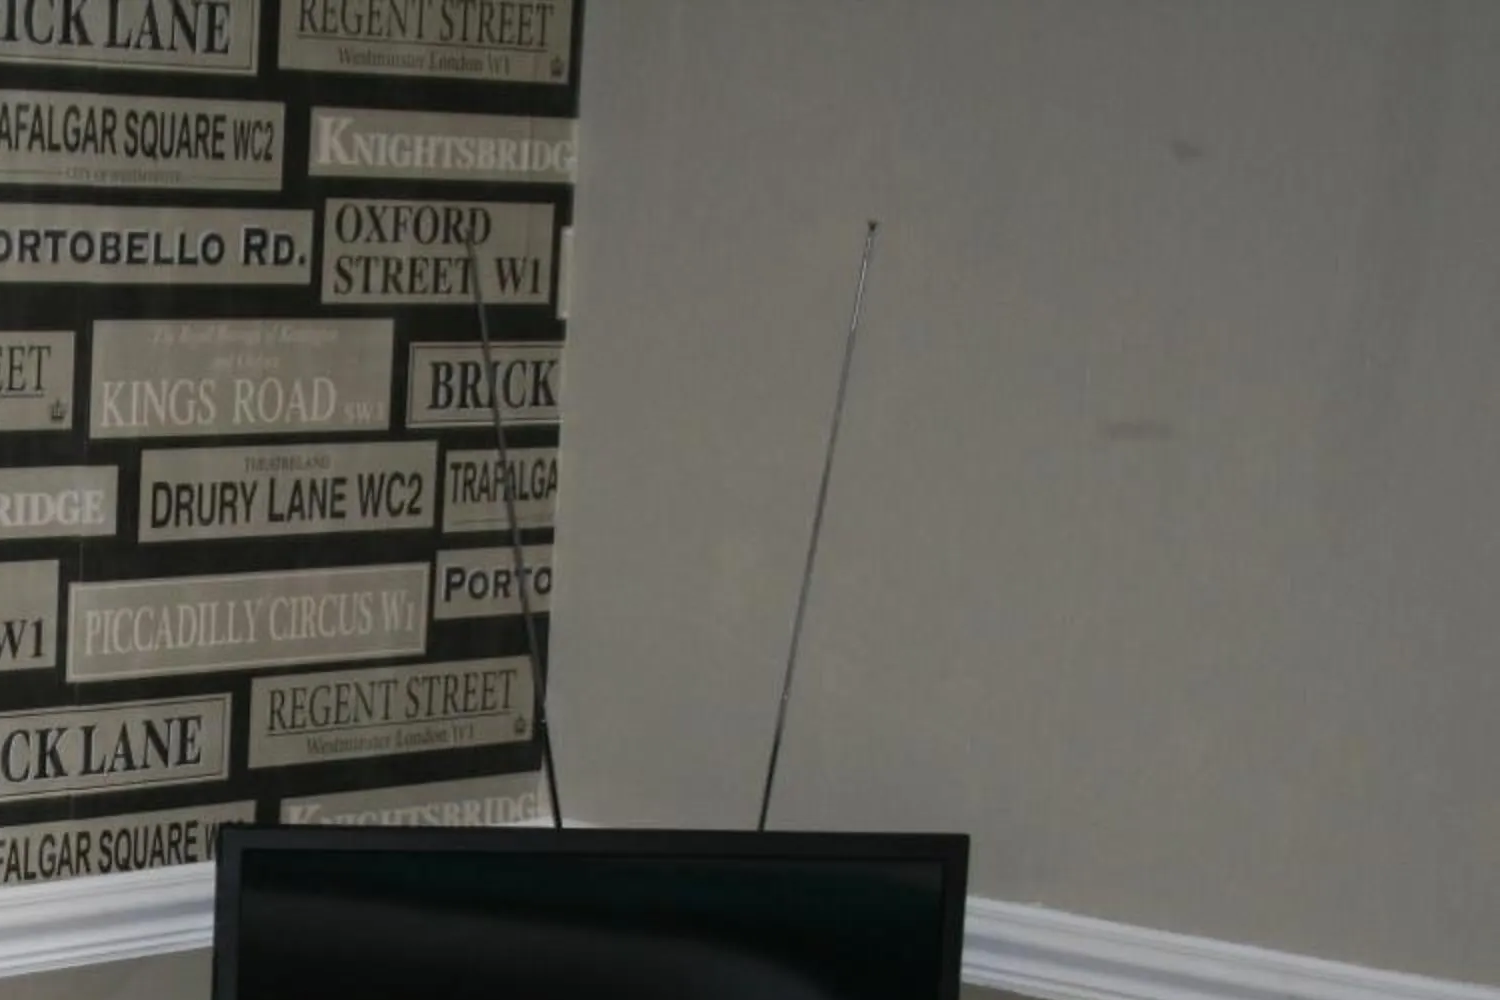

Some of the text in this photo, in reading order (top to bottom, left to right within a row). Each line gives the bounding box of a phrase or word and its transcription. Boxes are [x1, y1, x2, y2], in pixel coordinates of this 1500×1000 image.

[104, 0, 230, 54] LANE
[300, 0, 554, 47] REGENT STREET
[124, 109, 226, 160] SQUARE
[233, 121, 273, 162] WC2
[243, 227, 305, 267] RD.
[335, 204, 491, 245] OXFORD
[334, 255, 541, 295] STREET W1
[101, 379, 216, 427] KINGS
[232, 377, 336, 424] ROAD
[152, 472, 423, 528] DRURY LANE WC2
[85, 597, 267, 656] PICCADILLY
[269, 591, 373, 642] CIRCUS
[268, 670, 516, 731] REGENT STREET
[79, 715, 202, 776] LANE
[98, 820, 198, 874] SQUARE
